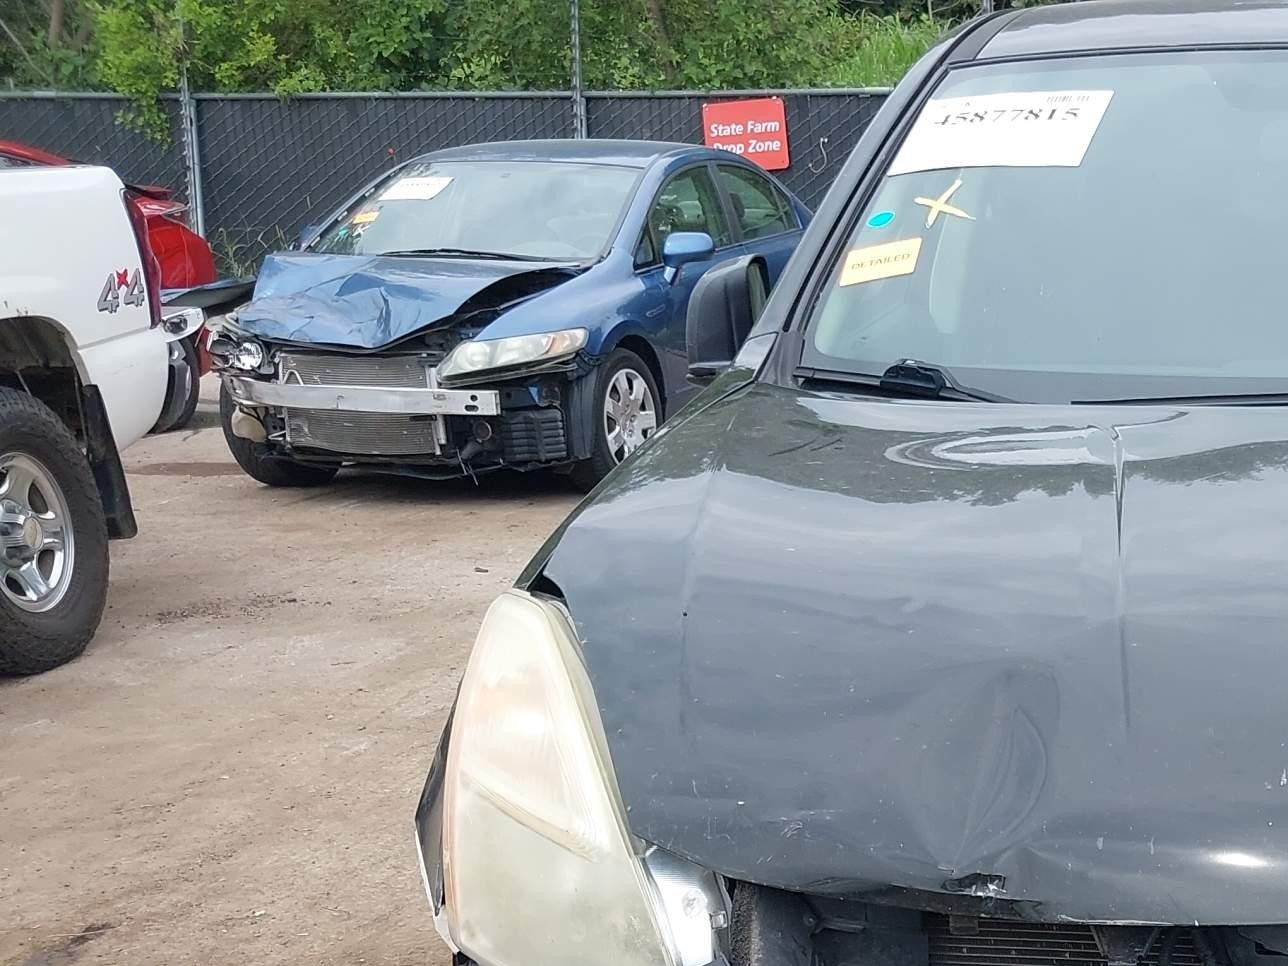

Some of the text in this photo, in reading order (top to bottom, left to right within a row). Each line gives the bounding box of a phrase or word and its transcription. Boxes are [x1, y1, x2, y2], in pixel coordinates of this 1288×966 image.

[934, 107, 1081, 126] 45877815
[710, 120, 780, 137] State Farm
[747, 139, 781, 153] Zone
[850, 253, 911, 270] DETAILED
